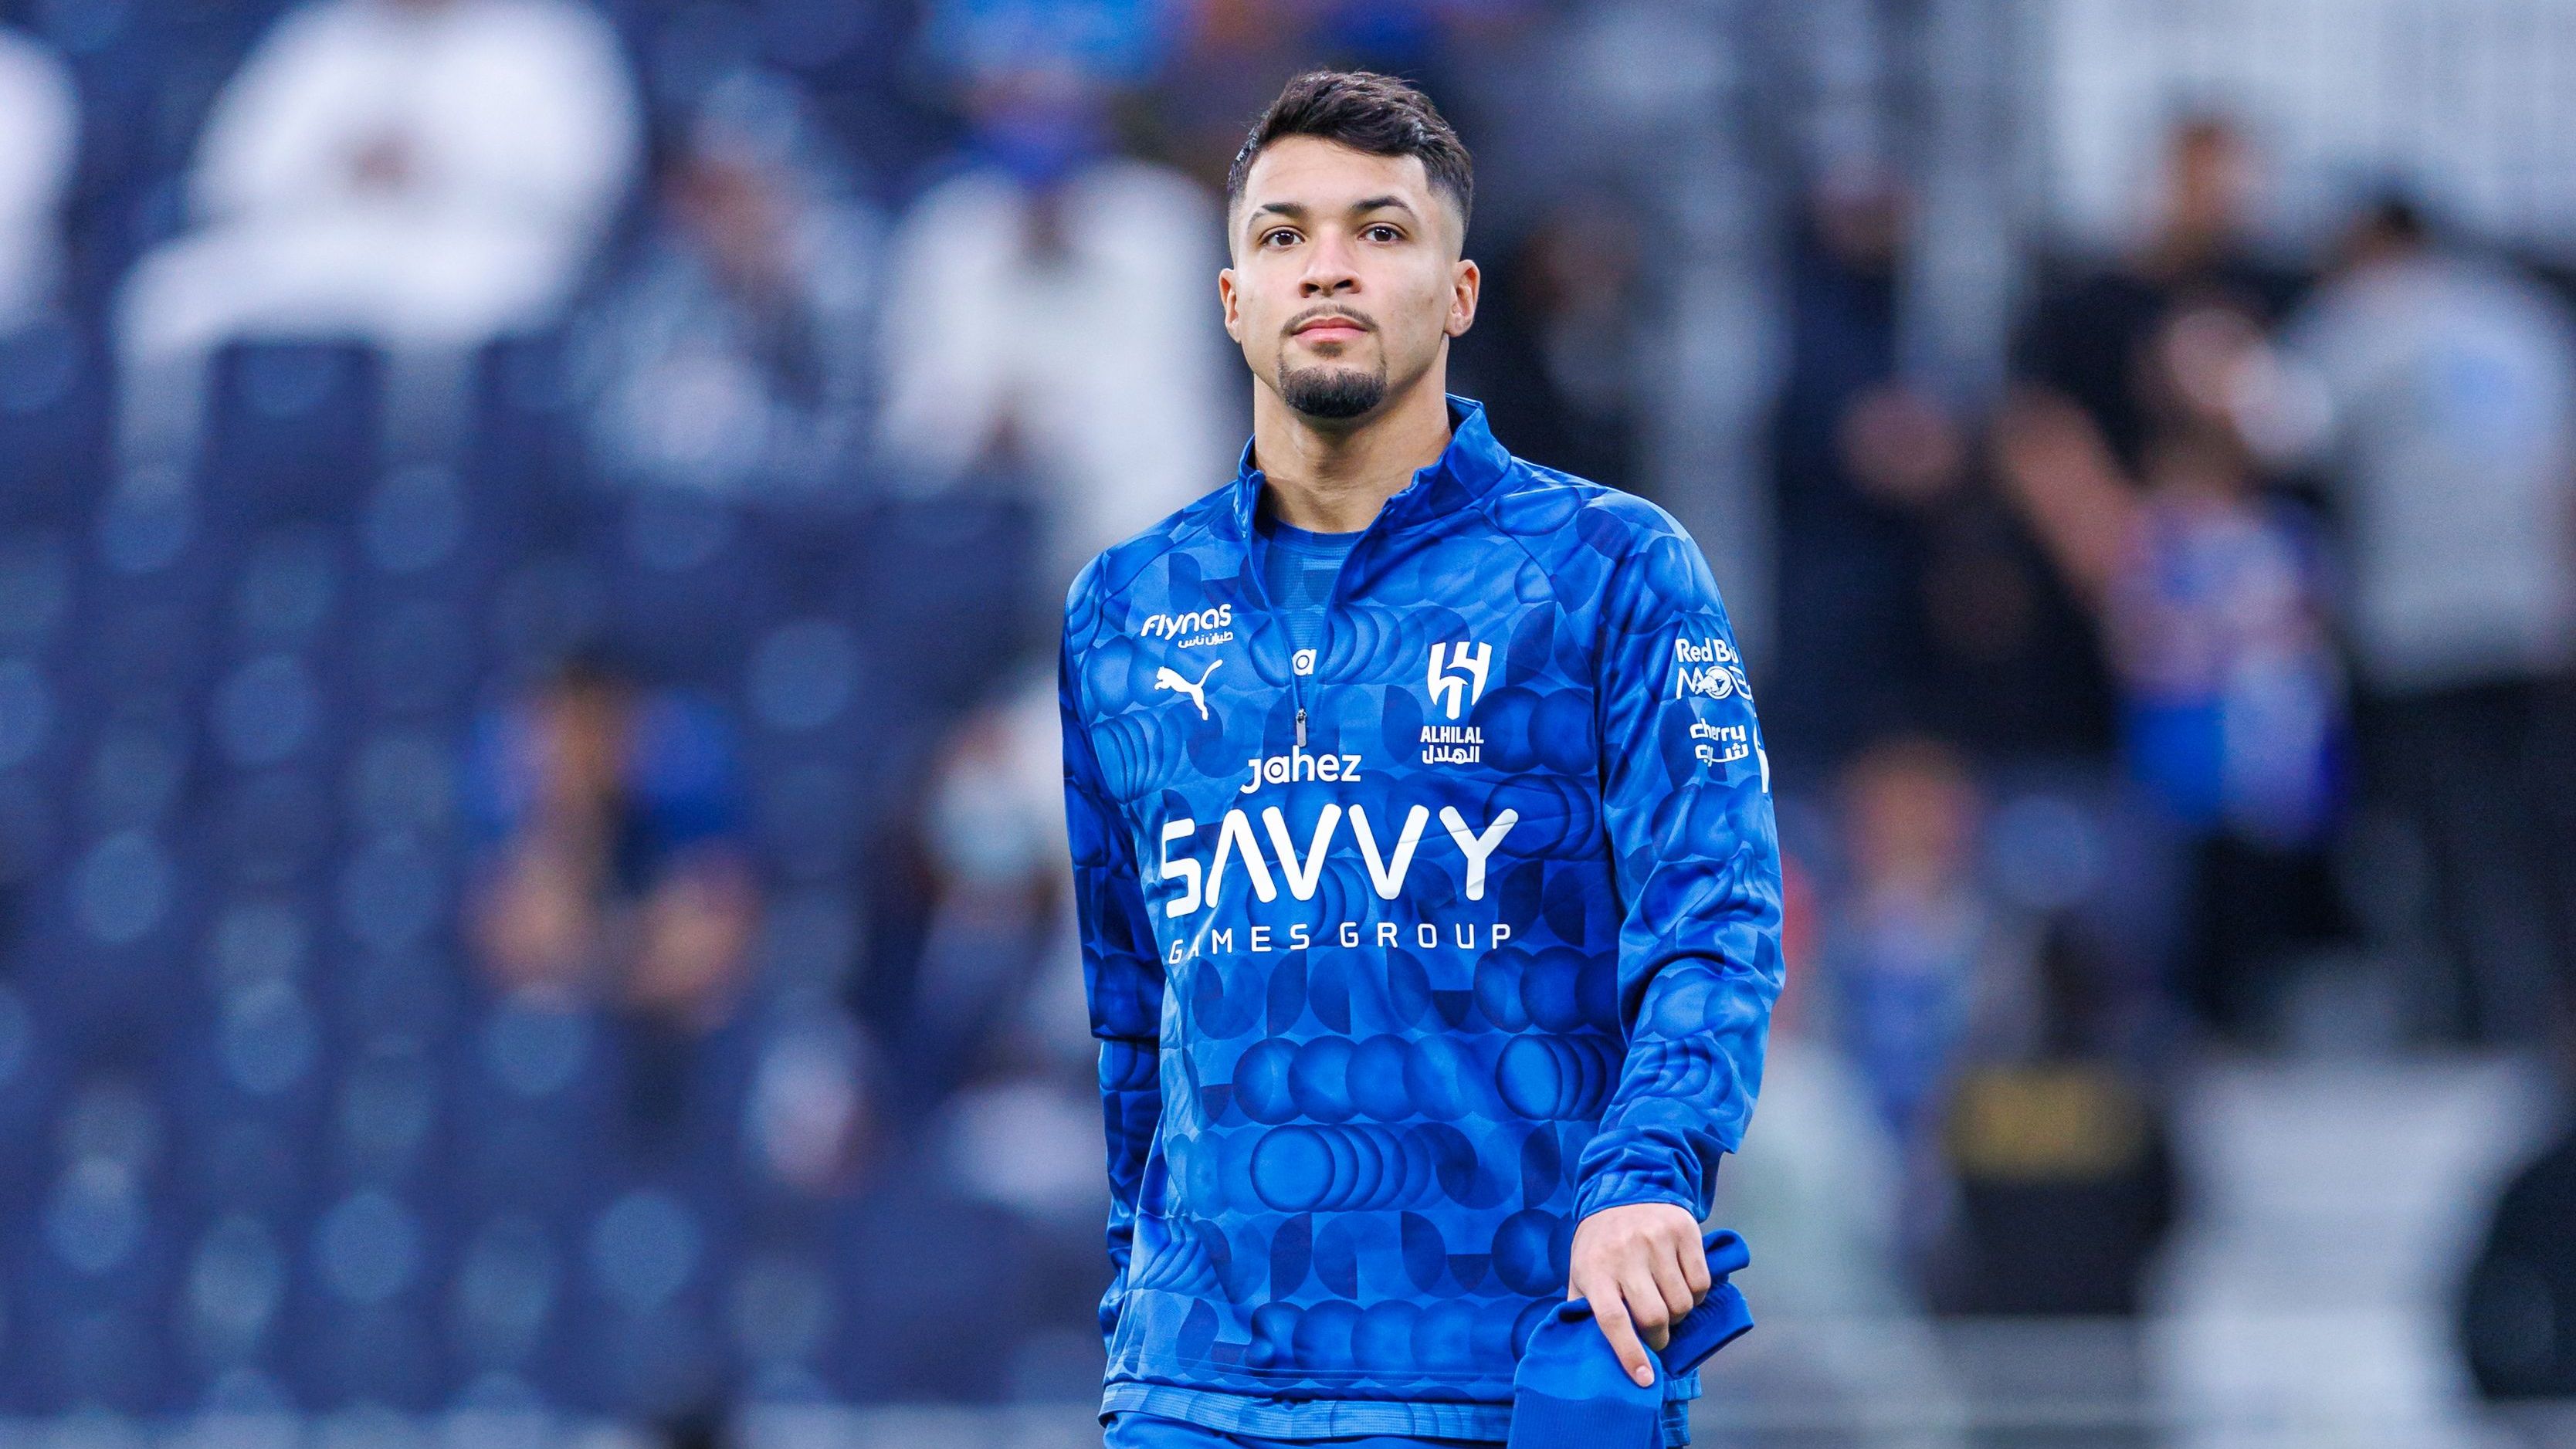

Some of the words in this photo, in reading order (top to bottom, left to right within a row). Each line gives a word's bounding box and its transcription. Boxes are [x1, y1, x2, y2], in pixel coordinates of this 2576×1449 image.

[1675, 637, 1714, 662] Red
[1713, 638, 1740, 664] Bu
[1419, 725, 1484, 744] ALHILAL
[1239, 746, 1361, 794] jahez
[1422, 744, 1480, 764] الهلال
[1160, 803, 1519, 918] SAVVY
[1168, 923, 1310, 965] GAMES
[1339, 922, 1511, 950] GROUP
